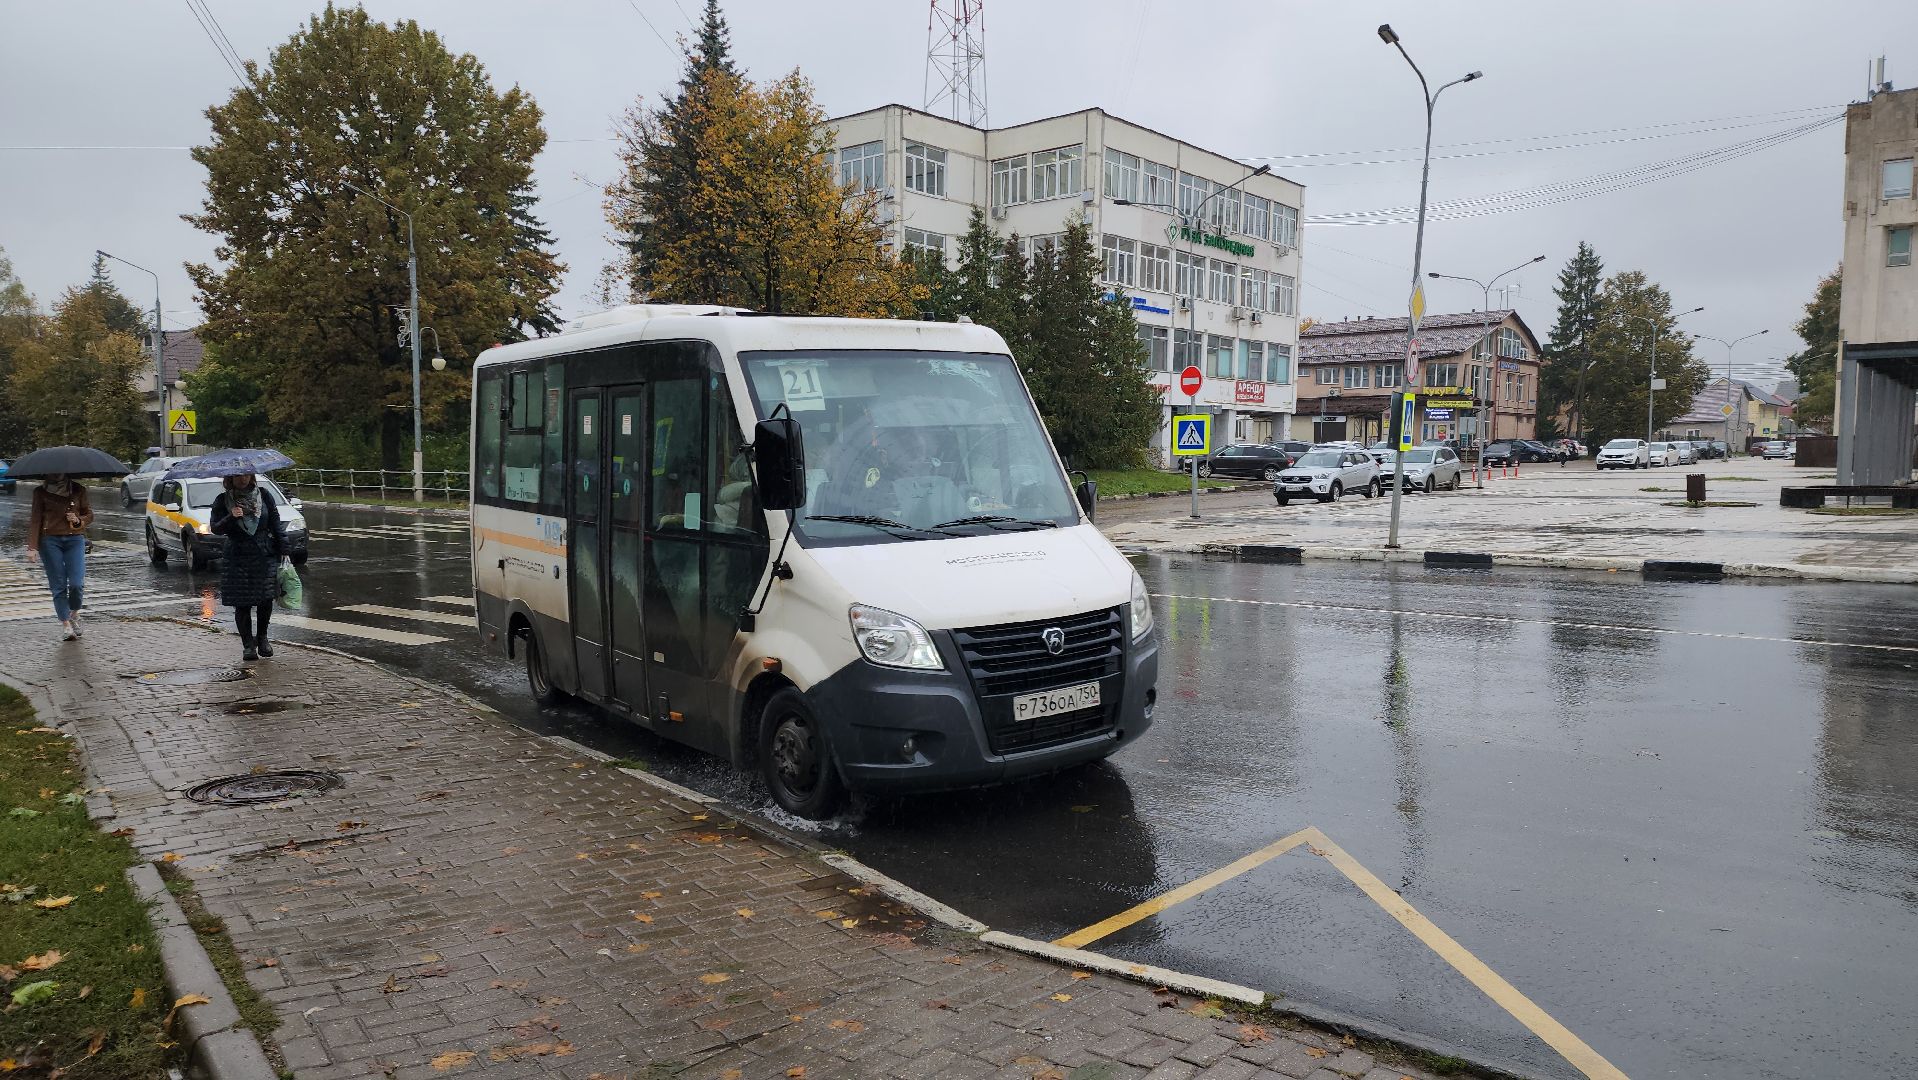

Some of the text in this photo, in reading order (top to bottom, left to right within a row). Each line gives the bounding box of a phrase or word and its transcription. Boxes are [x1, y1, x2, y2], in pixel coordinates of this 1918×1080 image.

[784, 369, 819, 394] 21
[1237, 382, 1264, 395] АРЕНДА
[1076, 685, 1098, 702] 750
